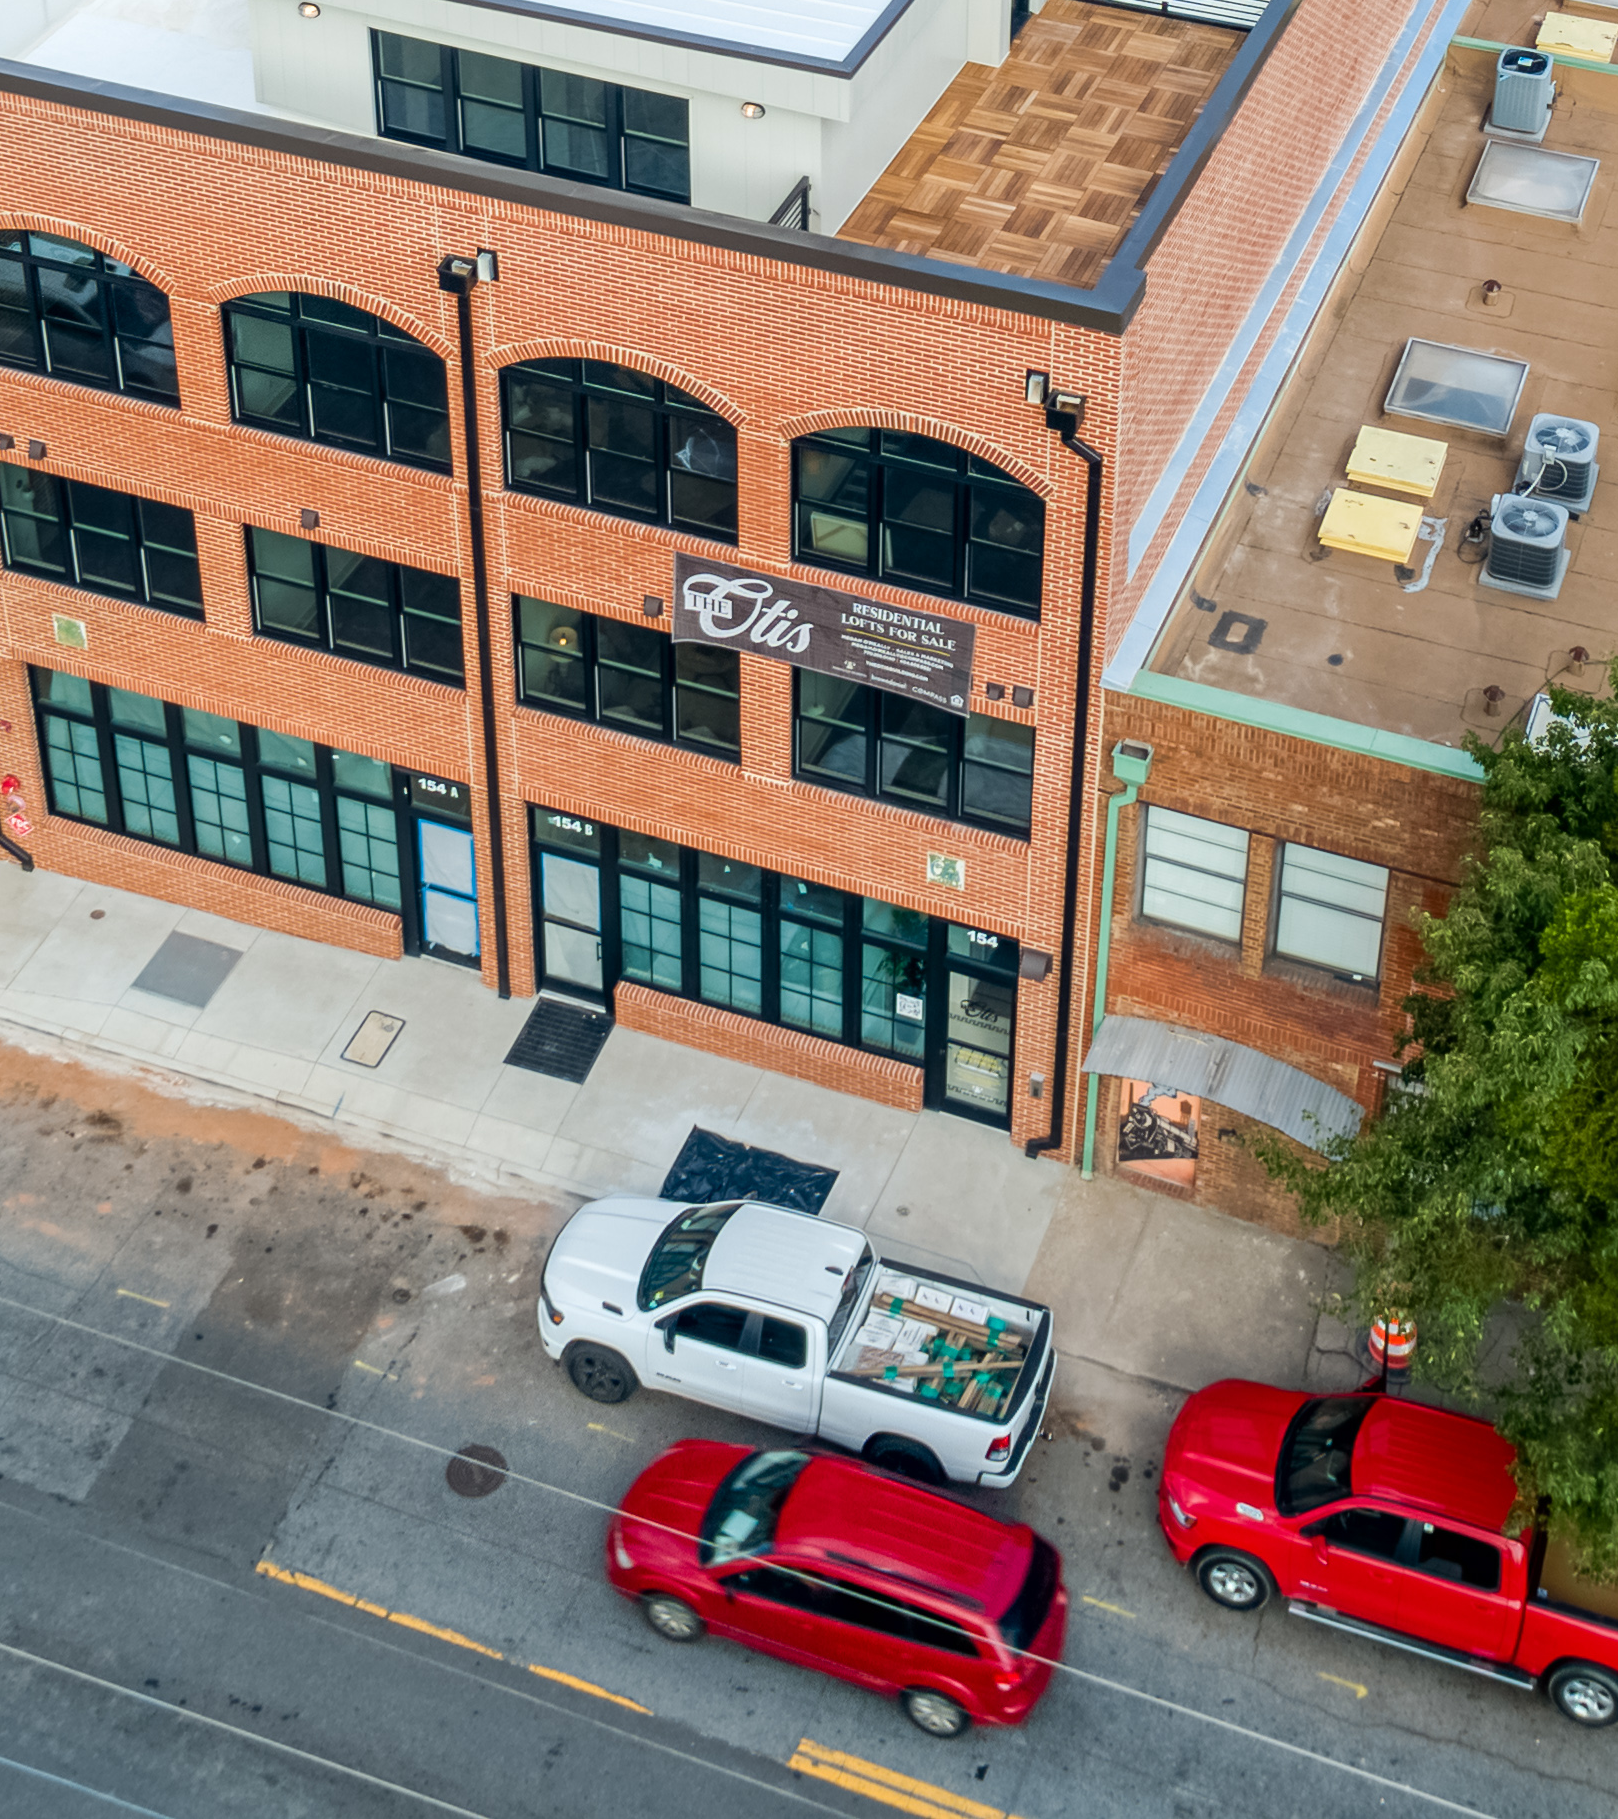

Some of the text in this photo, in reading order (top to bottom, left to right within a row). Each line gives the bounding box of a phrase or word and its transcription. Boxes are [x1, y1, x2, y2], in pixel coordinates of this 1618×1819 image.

[682, 573, 815, 654] Otis
[689, 592, 730, 616] THE
[852, 602, 945, 635] RESIDENTIAL
[841, 613, 957, 652] LOFTS FOR SALE
[911, 686, 948, 704] COMPASS
[418, 778, 459, 799] 154 A
[553, 815, 594, 836] 154 B
[967, 930, 998, 948] 154
